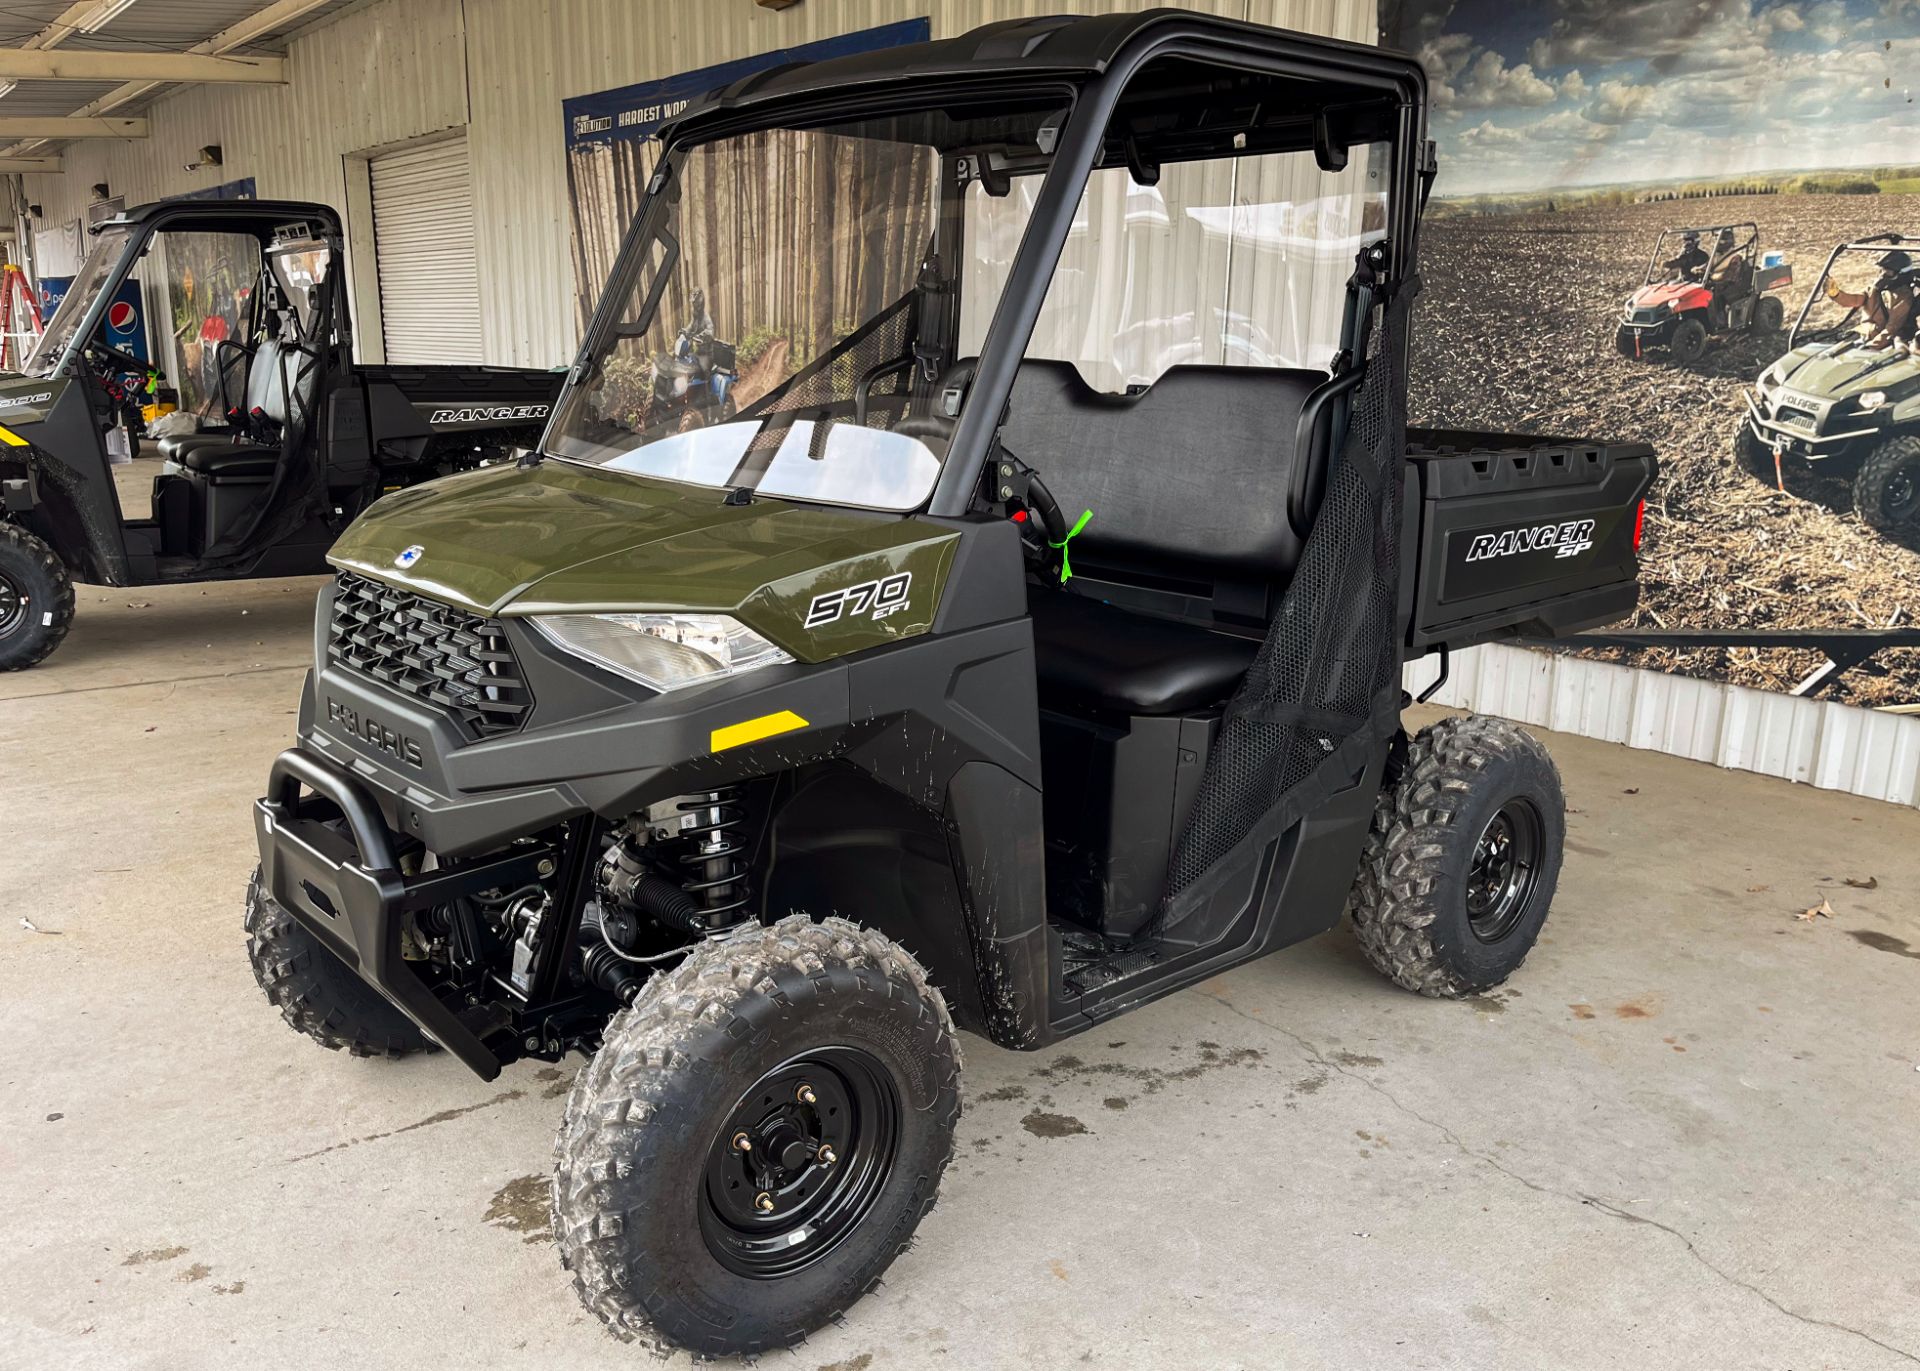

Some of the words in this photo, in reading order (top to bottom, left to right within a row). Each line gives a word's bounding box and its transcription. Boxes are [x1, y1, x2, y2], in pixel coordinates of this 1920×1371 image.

[618, 105, 661, 128] HARDEST
[663, 99, 690, 119] WOR
[430, 404, 549, 423] RANGER
[1466, 519, 1595, 562] RANGER
[1554, 541, 1594, 559] SP
[803, 571, 912, 629] 570
[871, 600, 911, 621] EFI
[327, 695, 423, 770] POLARIS
